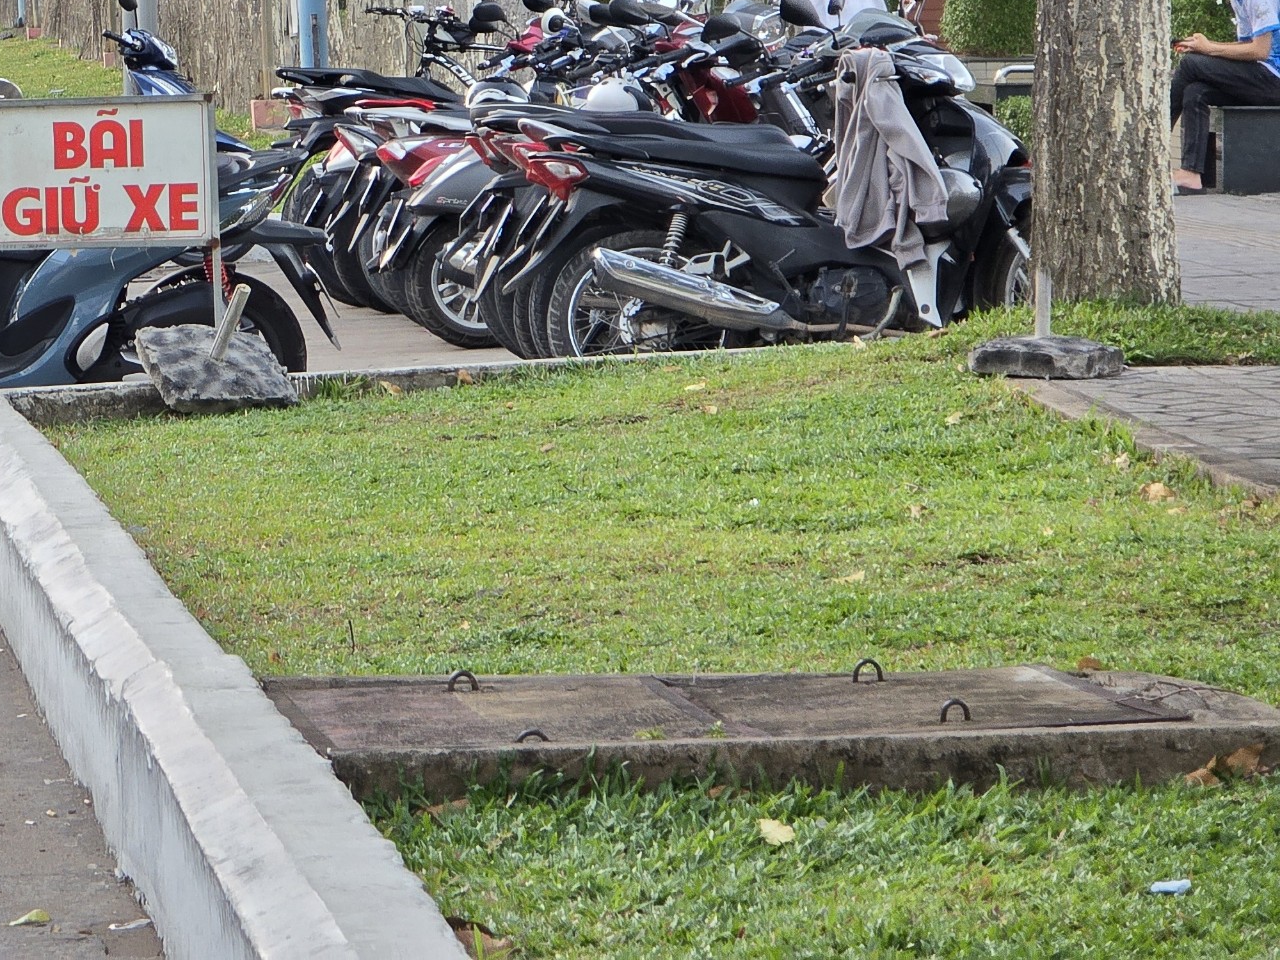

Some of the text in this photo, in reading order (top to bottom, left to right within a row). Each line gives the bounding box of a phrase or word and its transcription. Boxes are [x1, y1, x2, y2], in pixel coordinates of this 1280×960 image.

[52, 108, 144, 170] BÃI
[1, 175, 199, 236] GIỮ XE
